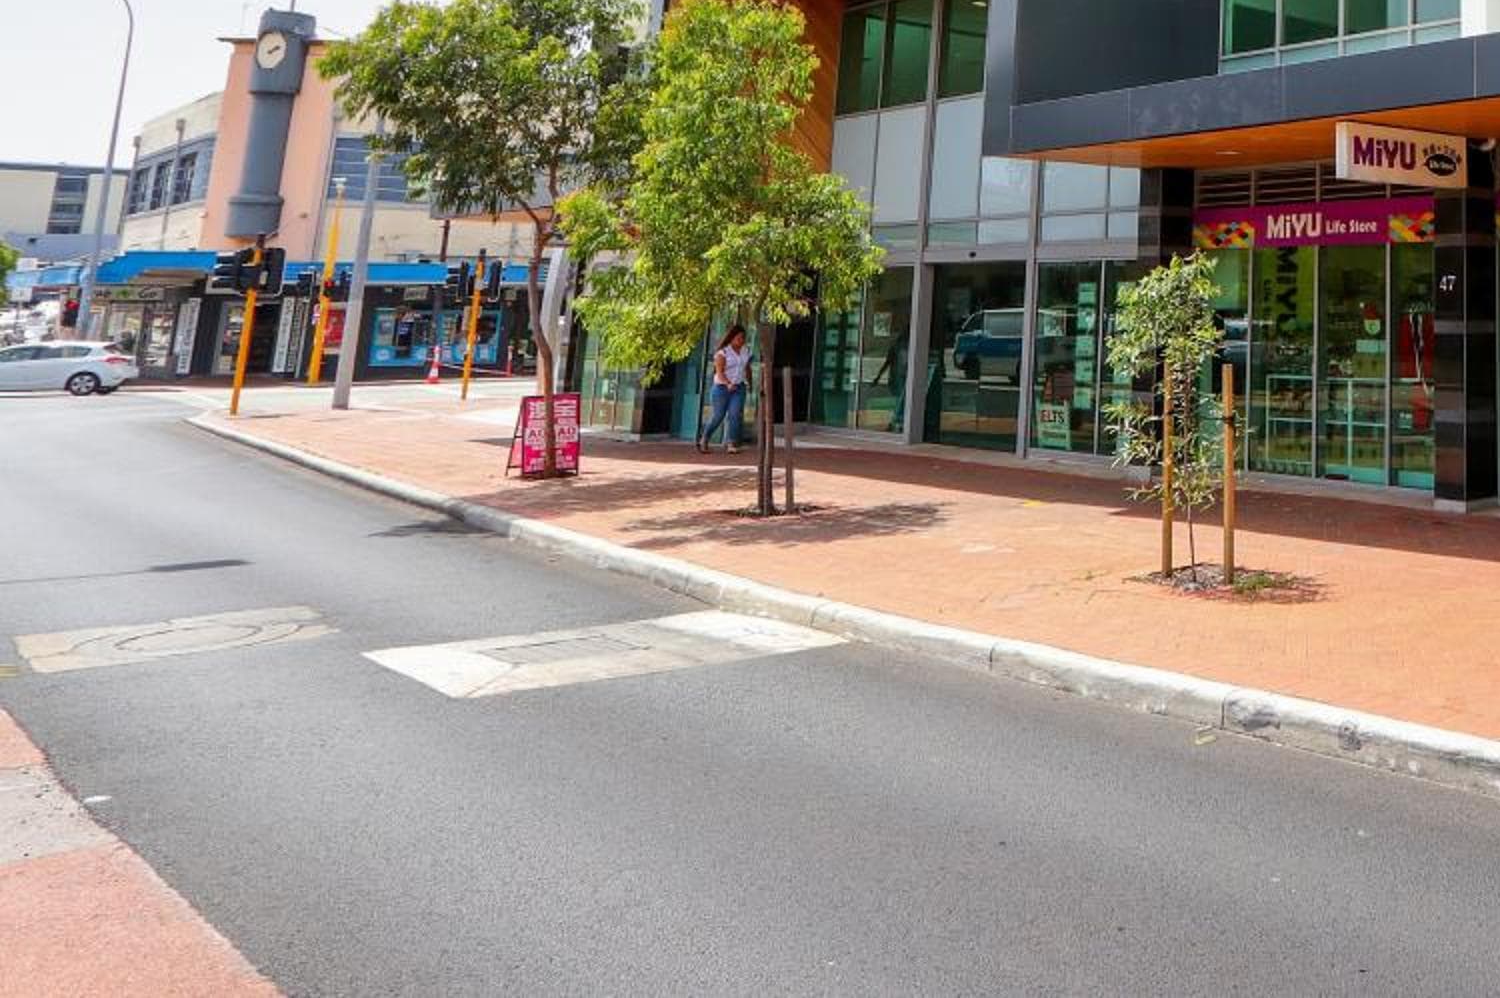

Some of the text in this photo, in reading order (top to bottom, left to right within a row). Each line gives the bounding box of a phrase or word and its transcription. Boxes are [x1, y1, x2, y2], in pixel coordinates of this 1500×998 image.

[1353, 135, 1416, 170] MiYU
[1266, 212, 1377, 239] MiYU Life Store
[1439, 275, 1457, 291] 47
